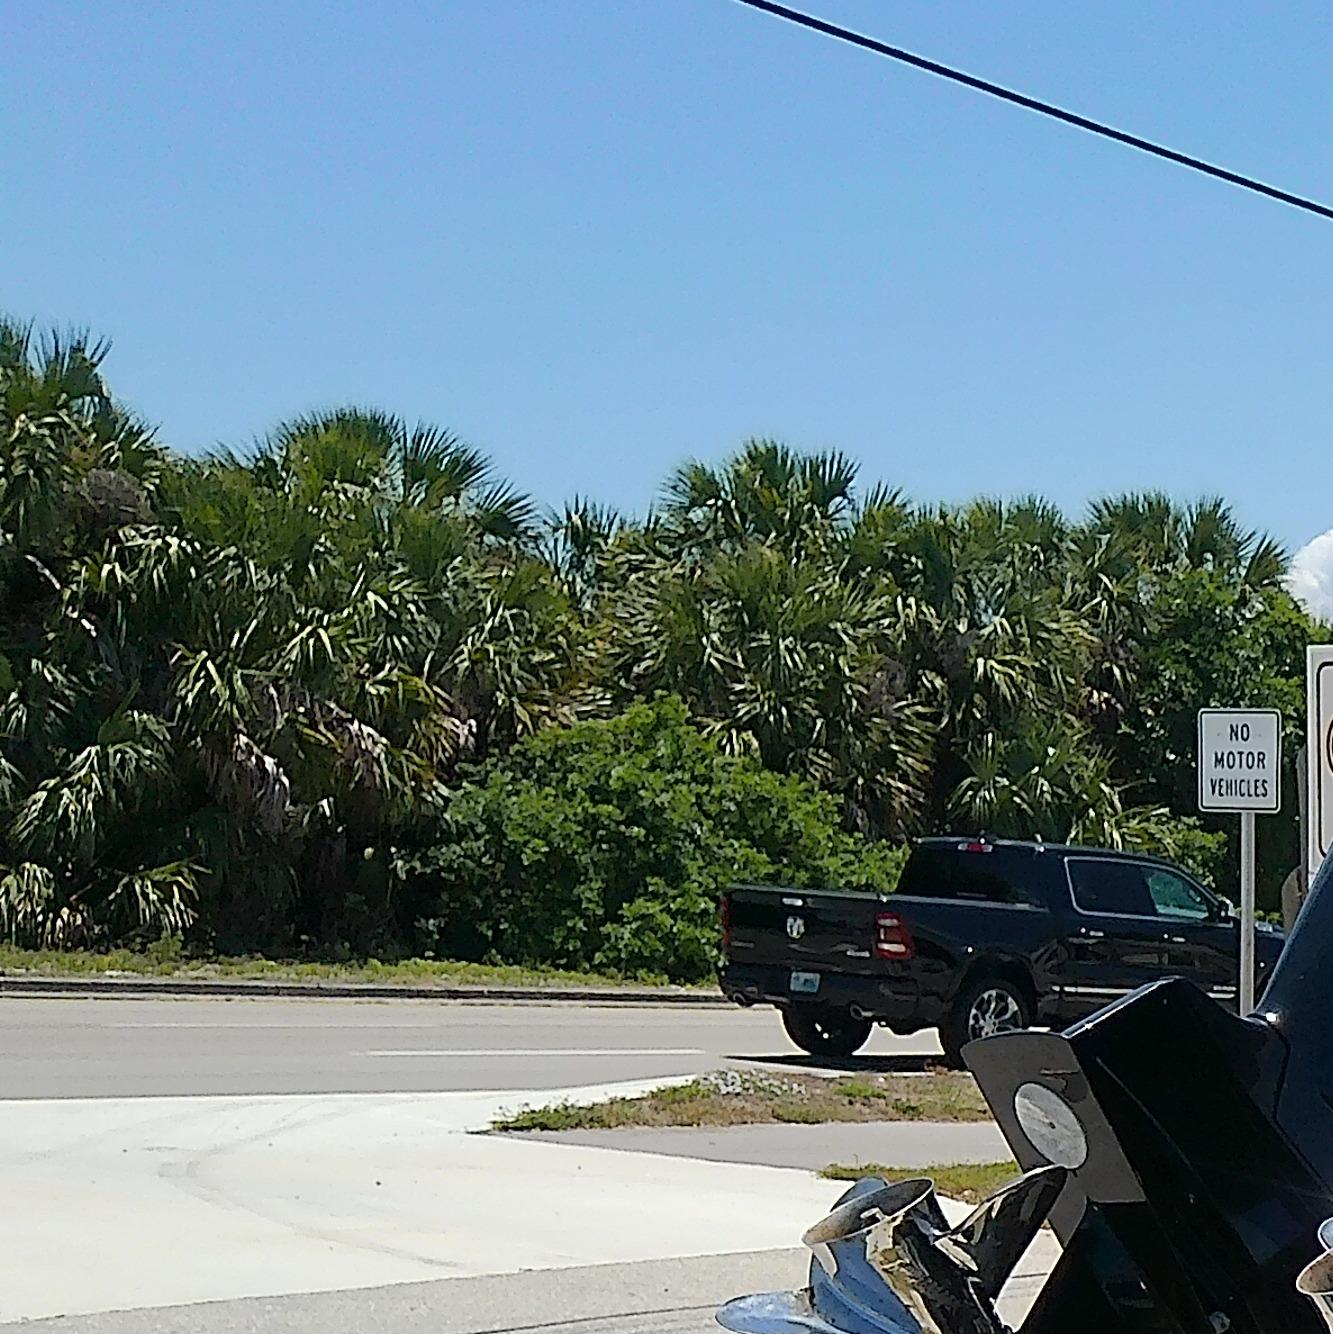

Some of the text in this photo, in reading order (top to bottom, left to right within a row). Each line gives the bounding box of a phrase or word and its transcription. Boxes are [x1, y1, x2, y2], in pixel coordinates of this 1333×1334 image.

[1229, 723, 1250, 742] NO
[1214, 750, 1267, 770] MOTOR
[1210, 777, 1269, 798] VEHICLES
